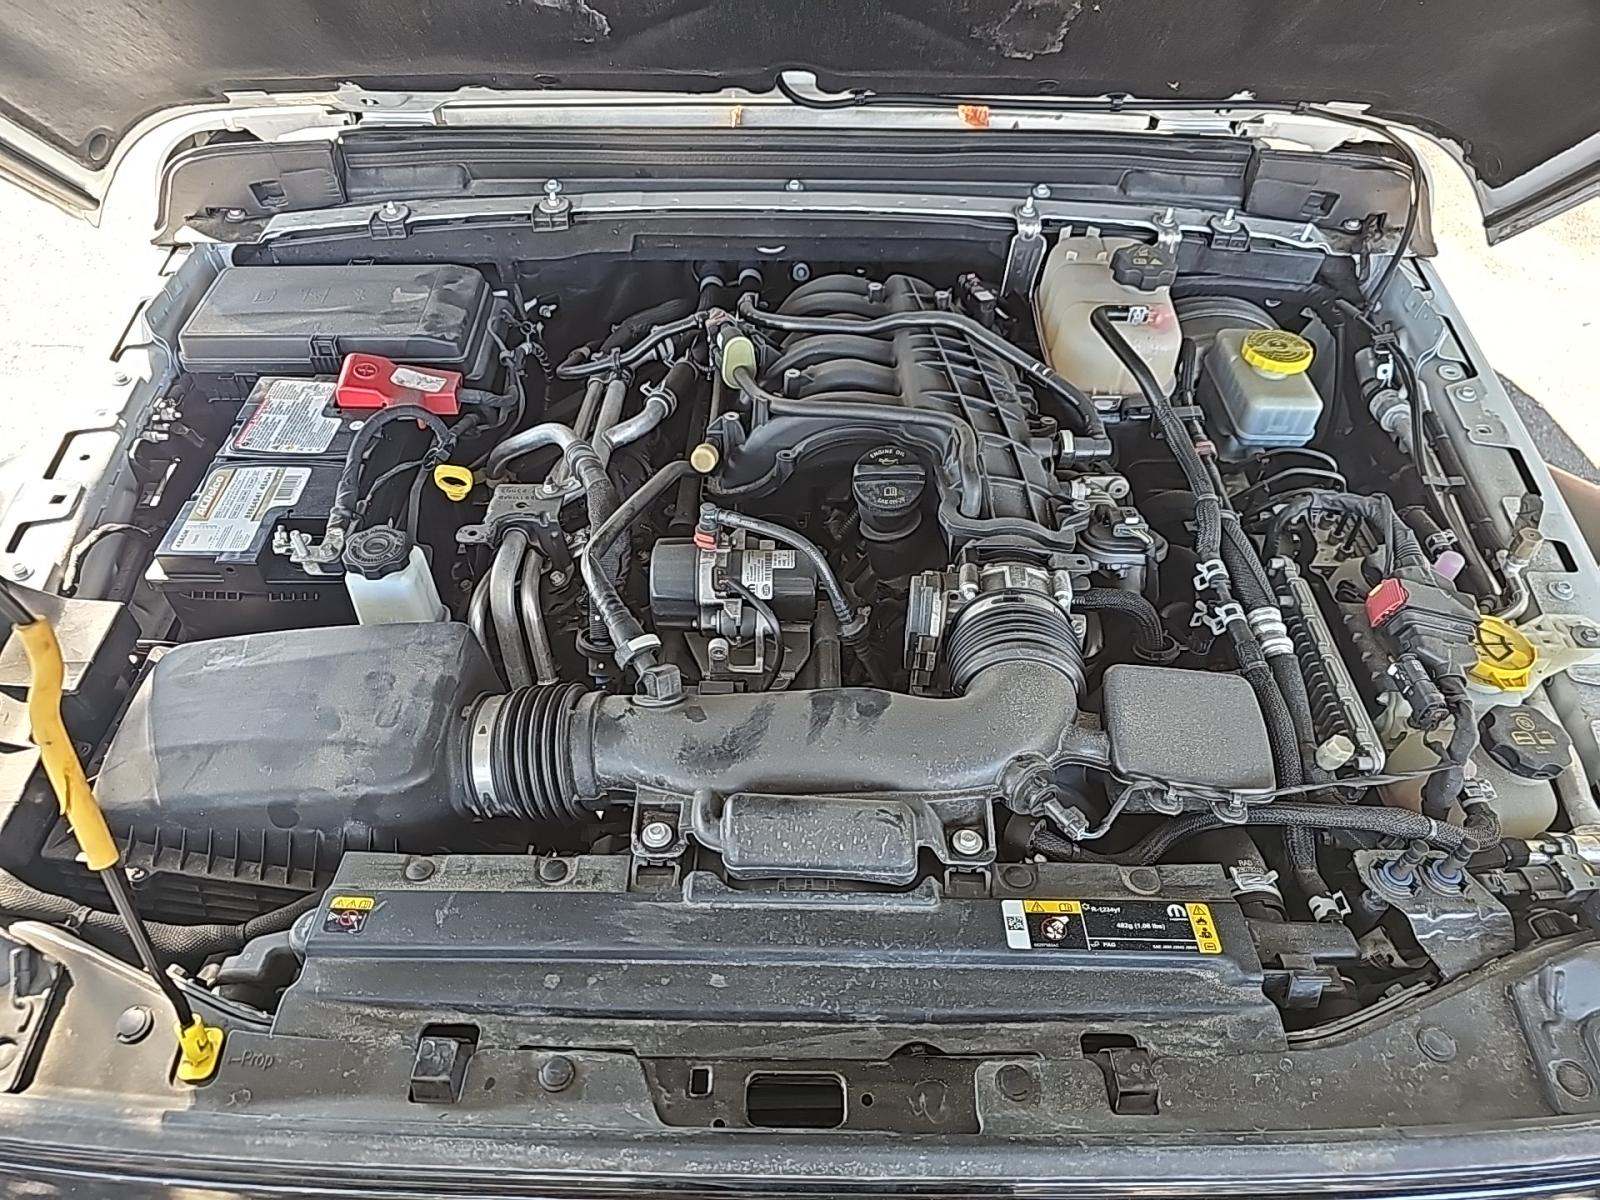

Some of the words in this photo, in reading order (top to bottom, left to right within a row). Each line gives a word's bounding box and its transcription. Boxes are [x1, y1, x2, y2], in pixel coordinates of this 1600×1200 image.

[869, 448, 893, 459] ENGINE
[895, 449, 906, 458] OIL
[196, 474, 225, 518] ACDelco
[241, 1048, 274, 1071] Prop
